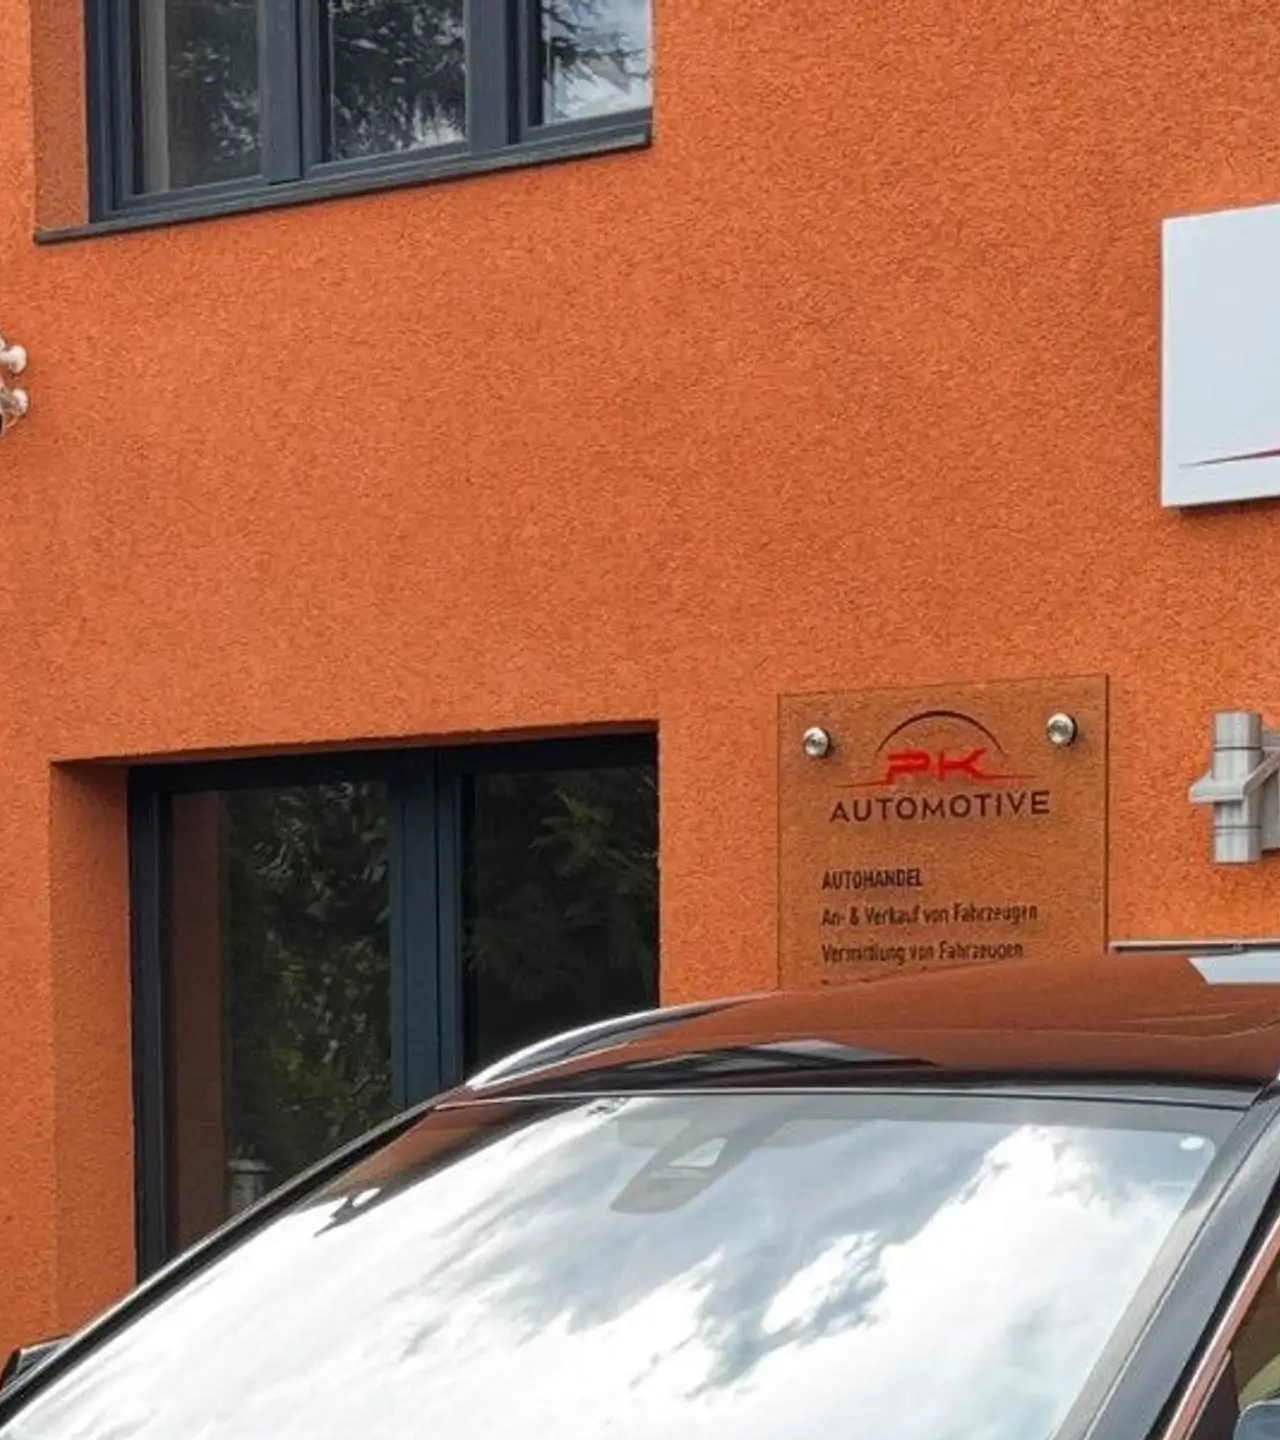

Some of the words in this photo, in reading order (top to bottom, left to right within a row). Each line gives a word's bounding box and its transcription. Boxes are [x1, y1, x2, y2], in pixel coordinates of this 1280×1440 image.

[886, 747, 988, 785] PK
[829, 789, 1051, 823] AUTOMOTIVE
[821, 868, 924, 890] AUTOHANDEL
[865, 904, 920, 926] Verkauf
[923, 907, 950, 925] von
[953, 901, 1039, 925] Fahrzeugen
[938, 940, 1024, 961] Fahrzeugen
